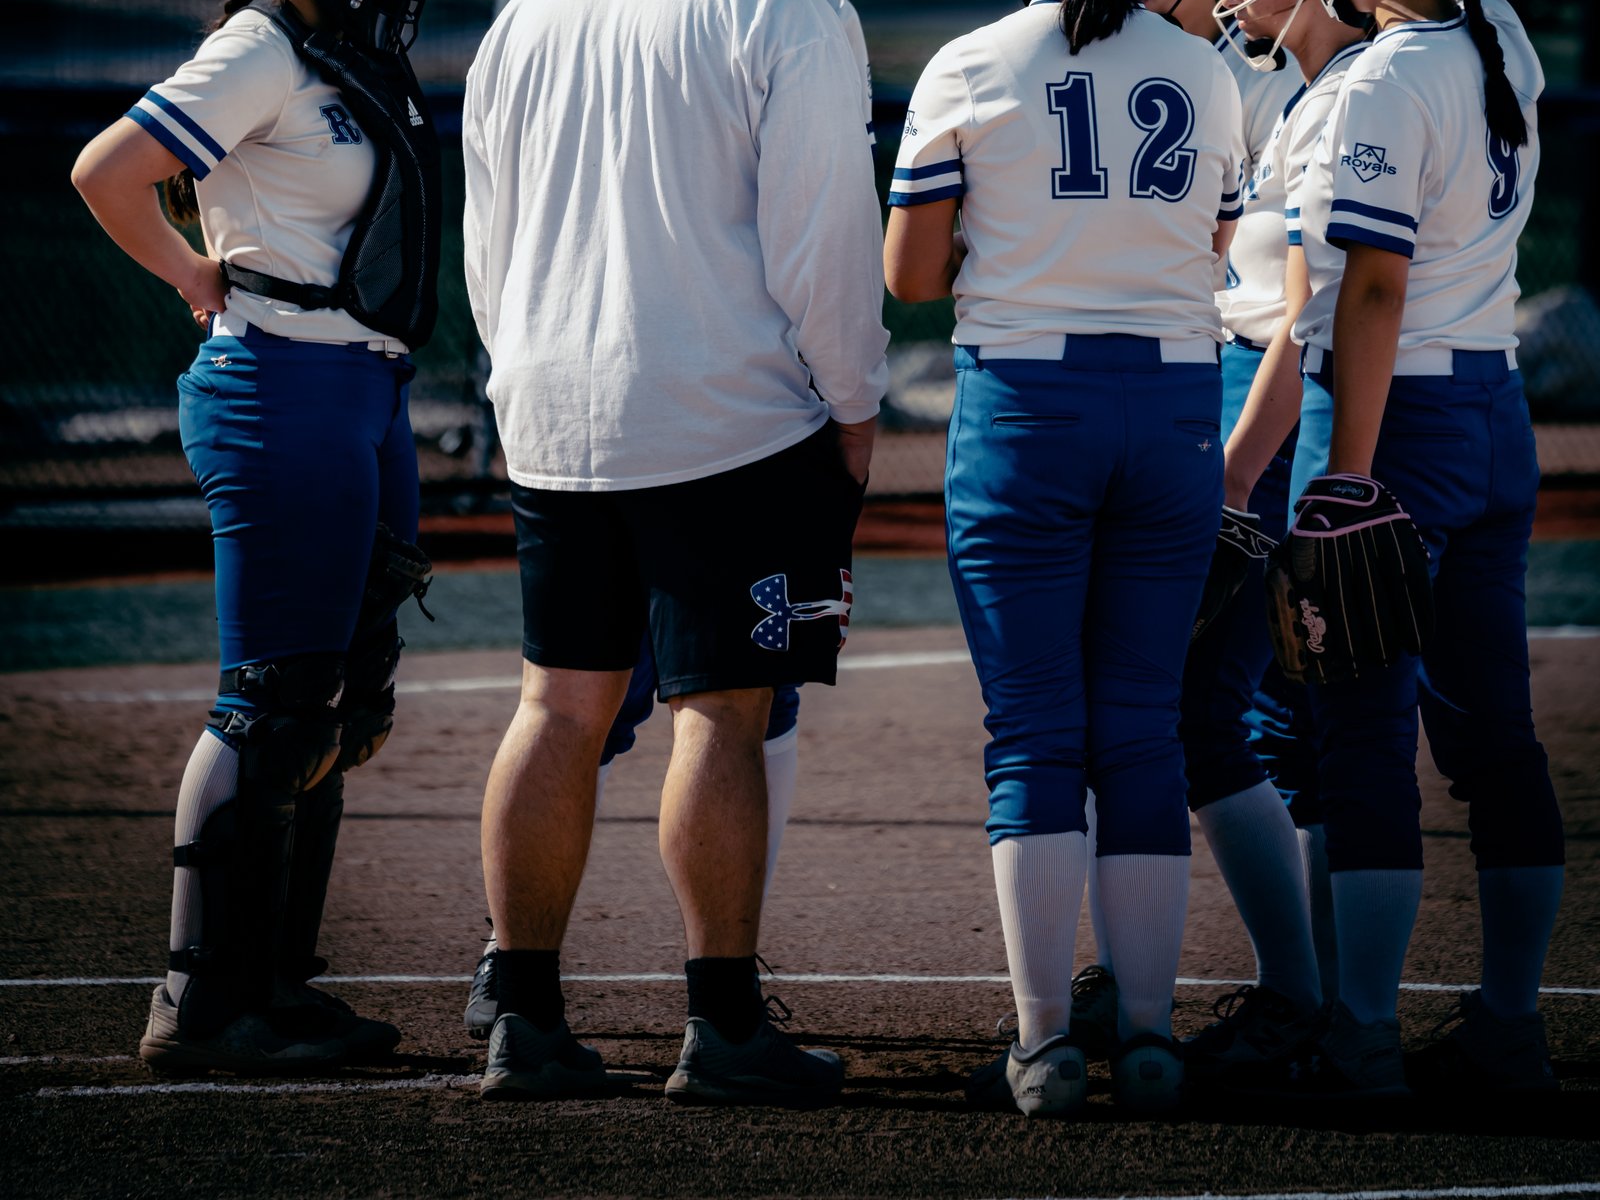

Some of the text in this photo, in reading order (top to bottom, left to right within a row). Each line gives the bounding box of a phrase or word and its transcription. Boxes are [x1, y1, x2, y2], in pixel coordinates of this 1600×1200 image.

[319, 103, 362, 145] R
[1046, 71, 1198, 203] 12
[1340, 155, 1397, 175] Royals
